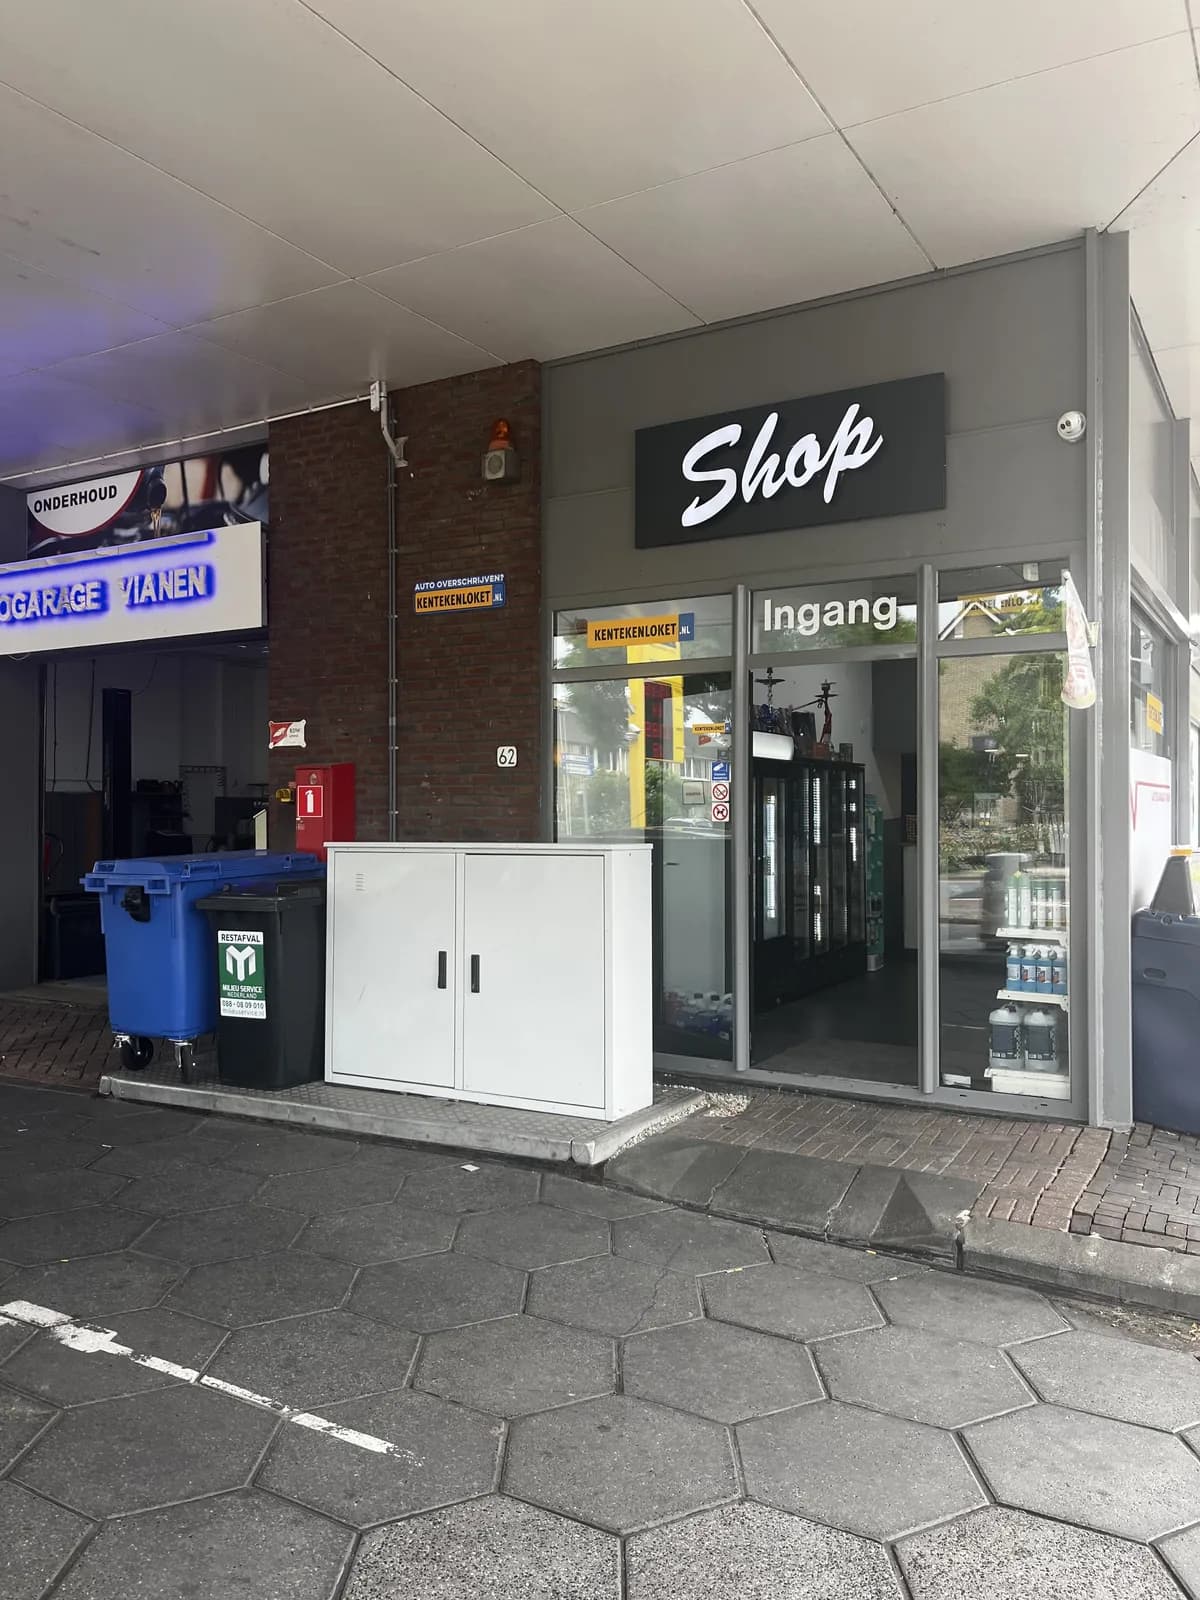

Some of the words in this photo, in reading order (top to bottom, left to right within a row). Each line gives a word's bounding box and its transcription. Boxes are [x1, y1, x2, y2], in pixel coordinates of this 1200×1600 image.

[681, 403, 884, 527] Shop
[33, 485, 118, 513] ONDERHOUD
[119, 565, 207, 606] VIANEN
[414, 582, 436, 591] AUTO
[436, 573, 505, 588] OVERSCHRIJVEN?
[416, 590, 491, 609] KENTEKENLOKET
[492, 593, 504, 602] .NL
[763, 595, 898, 636] Ingang
[594, 623, 677, 641] KENTEKENLOKET
[679, 625, 691, 635] .NL
[499, 748, 514, 764] 62
[222, 934, 260, 942] RESTAFVAL
[240, 985, 263, 993] SERVICE
